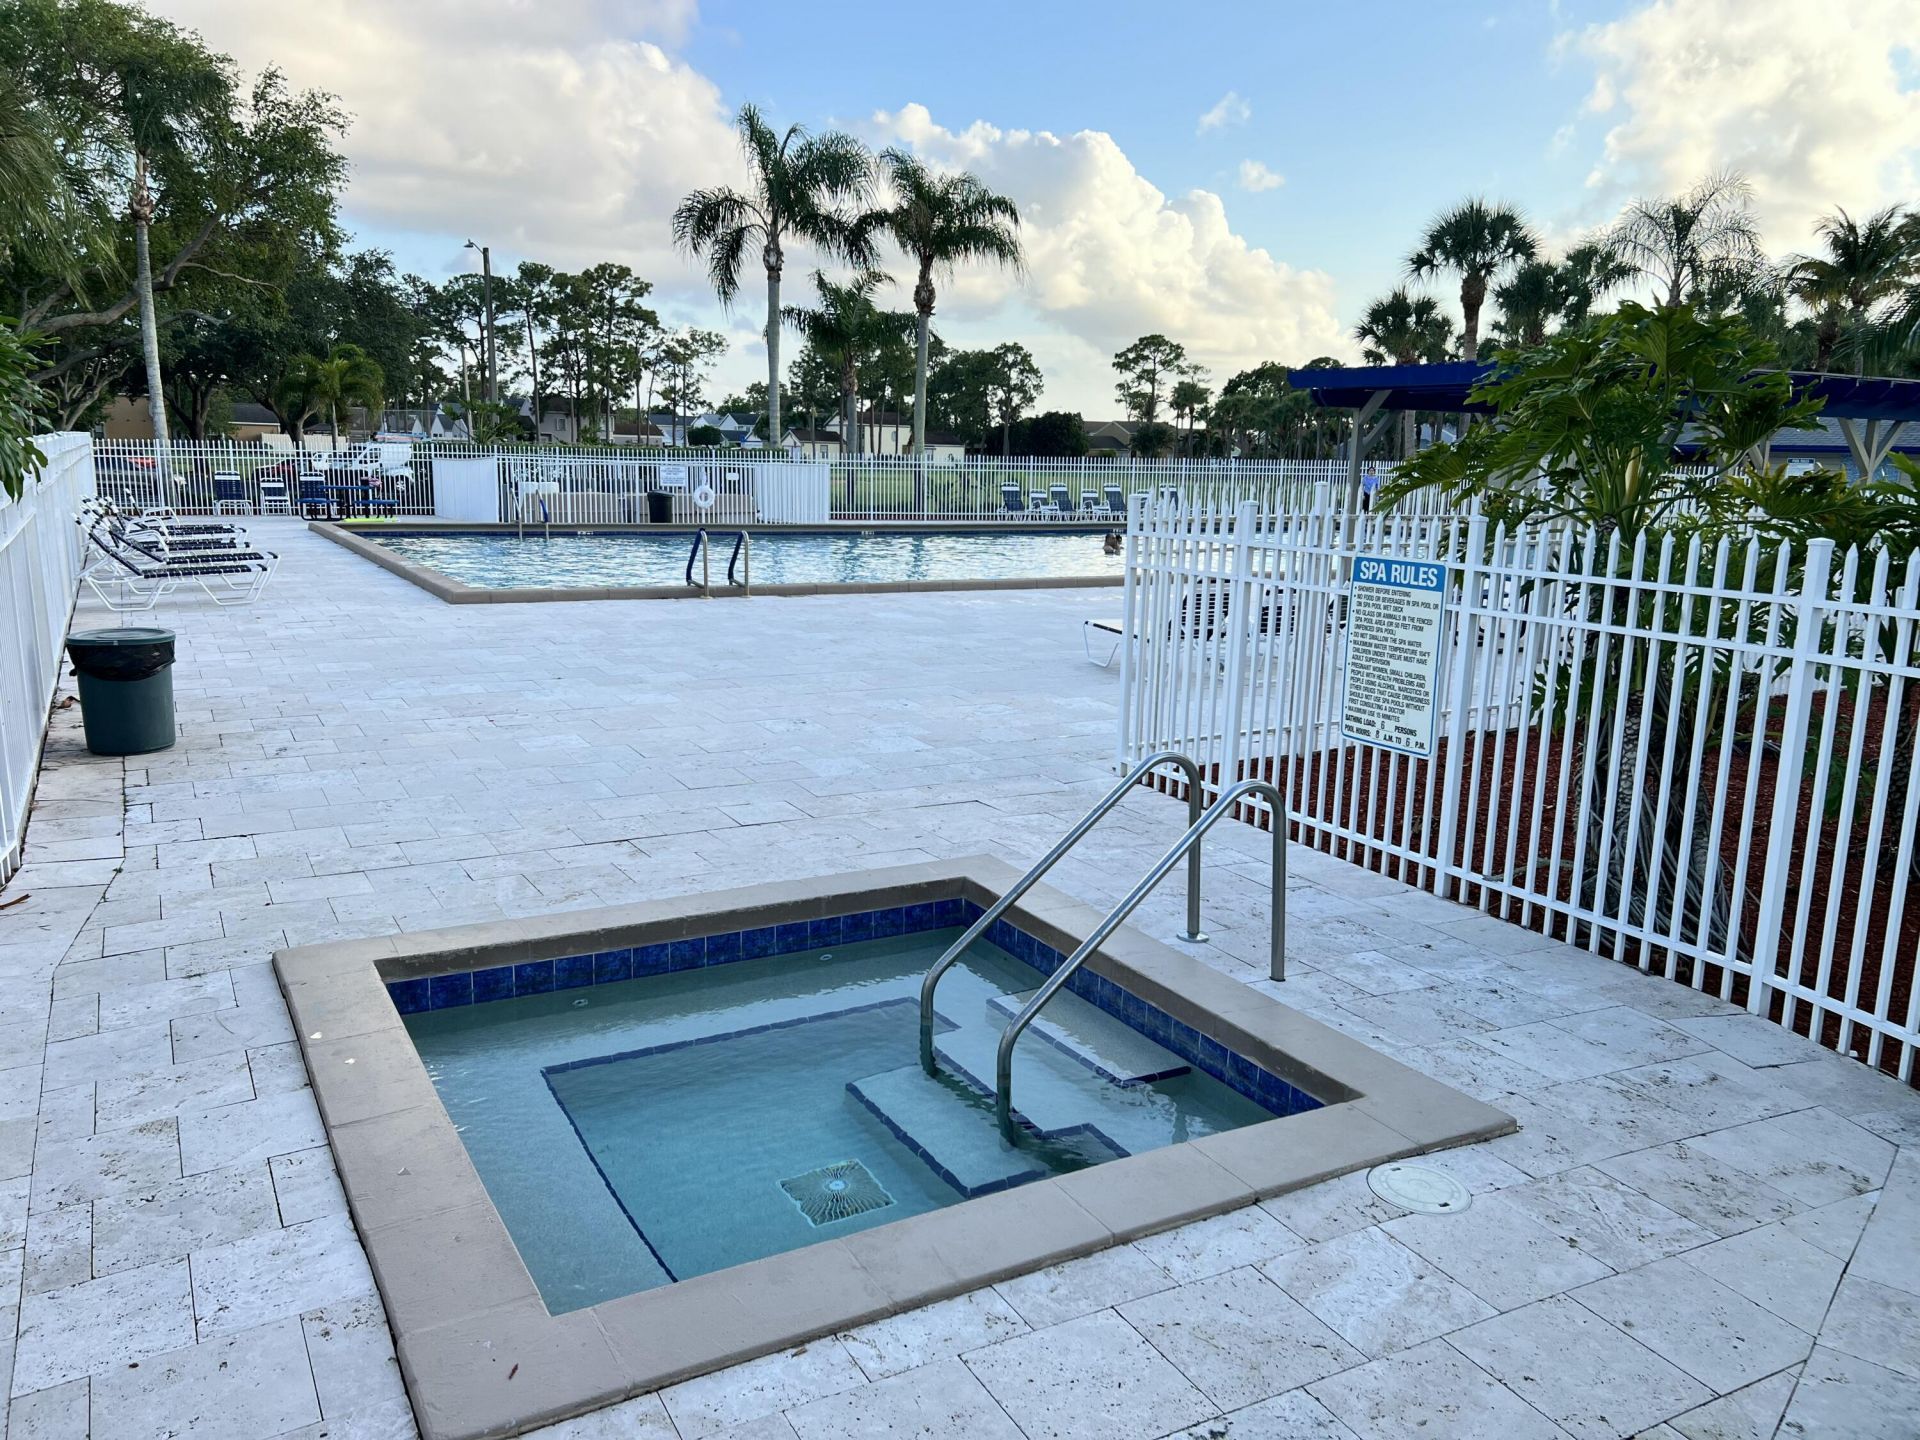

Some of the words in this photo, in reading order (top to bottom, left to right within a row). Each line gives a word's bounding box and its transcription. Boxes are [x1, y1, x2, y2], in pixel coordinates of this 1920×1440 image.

[1360, 561, 1386, 581] SPA
[1391, 564, 1438, 587] RULES
[1382, 596, 1405, 605] BEVERAGES
[1383, 612, 1401, 620] ANIMALS
[1416, 617, 1432, 625] FENCED
[1354, 623, 1374, 631] UNFENCED
[1369, 634, 1389, 642] SWALLOW
[1352, 647, 1371, 655] CHILDREN
[1387, 652, 1402, 661] TWELVE
[1353, 639, 1372, 648] MAXIMUM
[1389, 644, 1418, 656] TEMPERATURE
[1351, 661, 1371, 670] PREGNANT
[1389, 668, 1403, 676] SMALL
[1365, 656, 1390, 666] SUPERVISION
[1351, 669, 1364, 677] PEOPLE
[1376, 674, 1392, 682] HEALTH
[1393, 677, 1415, 687] PROBLEMS
[1350, 676, 1364, 684] PEOPLE
[1398, 685, 1422, 696] NARCOTICS
[1387, 690, 1401, 698] CAUSE
[1402, 694, 1430, 705] DROWSINESS
[1390, 698, 1404, 708] POOLS
[1405, 702, 1425, 712] WITHOUT
[1348, 705, 1367, 714] MAXIMUM
[1360, 700, 1383, 710] CONSULTING
[1388, 706, 1405, 715] DOCTOR
[1345, 714, 1363, 724] BATHING
[1364, 718, 1376, 727] LOAD:
[1380, 721, 1385, 730] 6
[1394, 725, 1417, 737] PERSONS
[1345, 724, 1355, 732] POOL
[1356, 726, 1371, 737] HOURS:
[1383, 734, 1394, 742] A.M.
[1406, 738, 1410, 747] 6
[1415, 741, 1426, 750] P.M.
